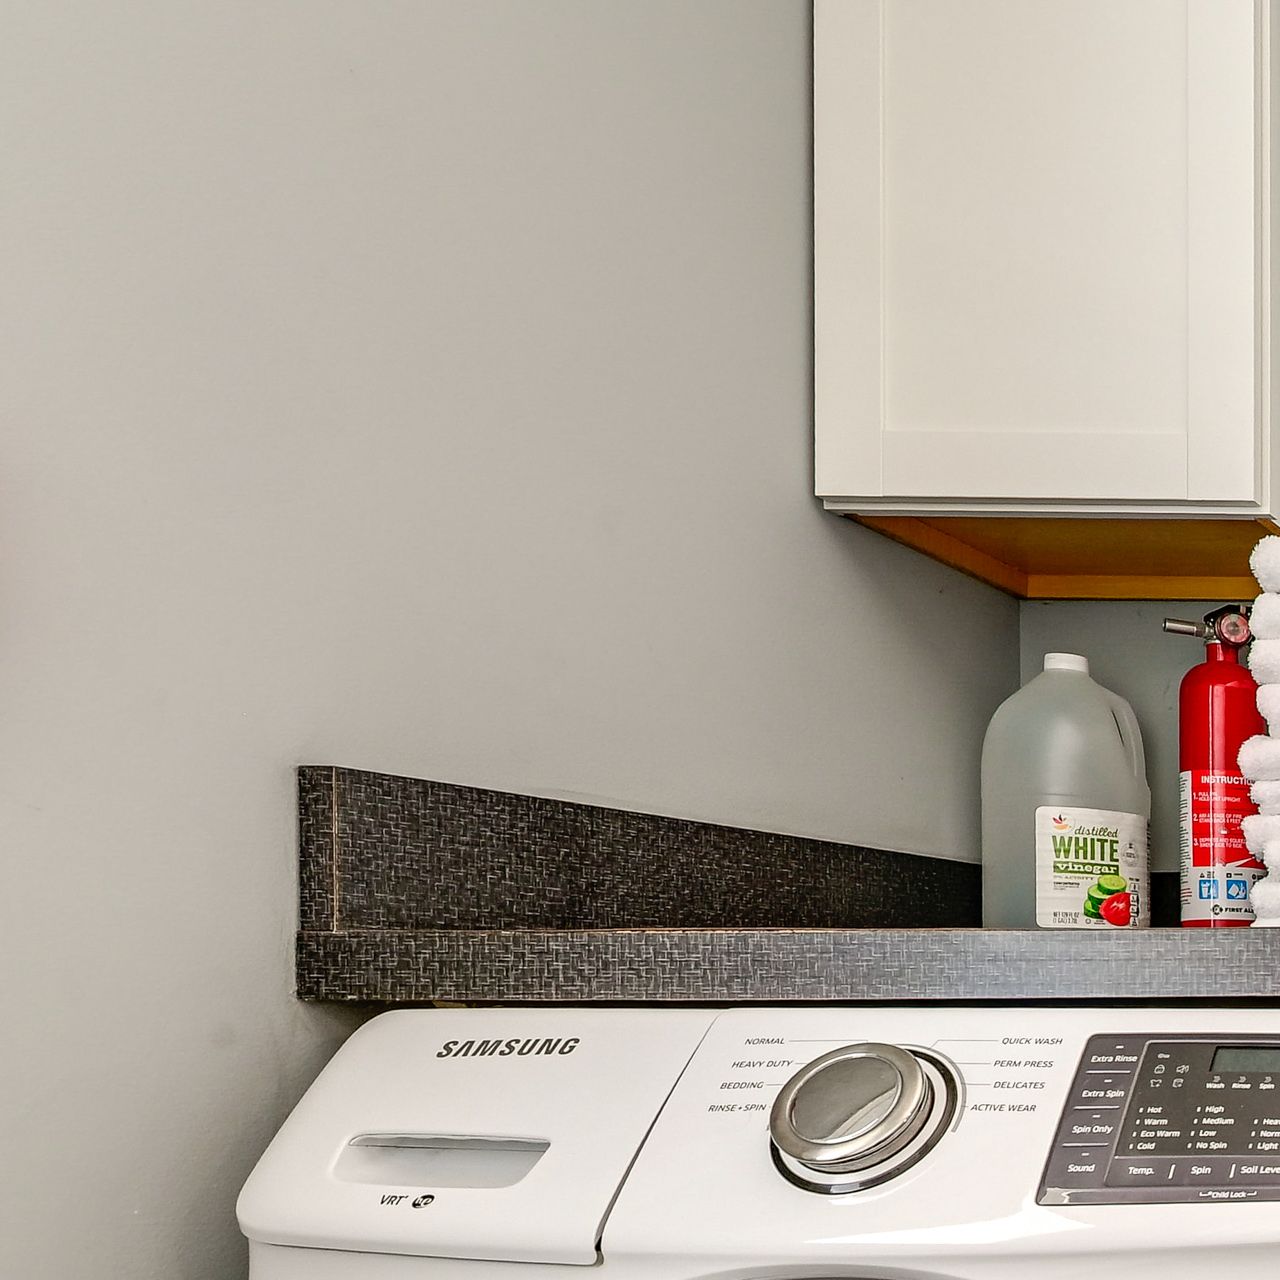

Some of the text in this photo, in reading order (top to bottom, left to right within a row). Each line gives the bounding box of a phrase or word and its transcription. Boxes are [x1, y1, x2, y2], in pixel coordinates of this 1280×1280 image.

[1201, 776, 1253, 786] INSTRUCTIO
[1074, 826, 1118, 838] distilled
[1052, 835, 1120, 862] WHITE
[1056, 862, 1117, 874] vinegar
[1002, 1037, 1063, 1045] QUICK WASH
[436, 1038, 580, 1058] SAMSUNG
[732, 1060, 793, 1068] HEAVY DUTY
[994, 1060, 1054, 1068] PERM PRESS
[1106, 1090, 1125, 1098] Spin
[970, 1104, 1036, 1112] ACTIVE WEAR
[1205, 1106, 1224, 1114] High
[1072, 1125, 1113, 1134] Spin Only
[1209, 1142, 1228, 1150] Spin
[1257, 1142, 1279, 1150] Light
[1067, 1164, 1095, 1172] Sound
[1128, 1166, 1154, 1175] Temp.
[1190, 1166, 1211, 1175] Spin
[1240, 1165, 1258, 1174] Soil
